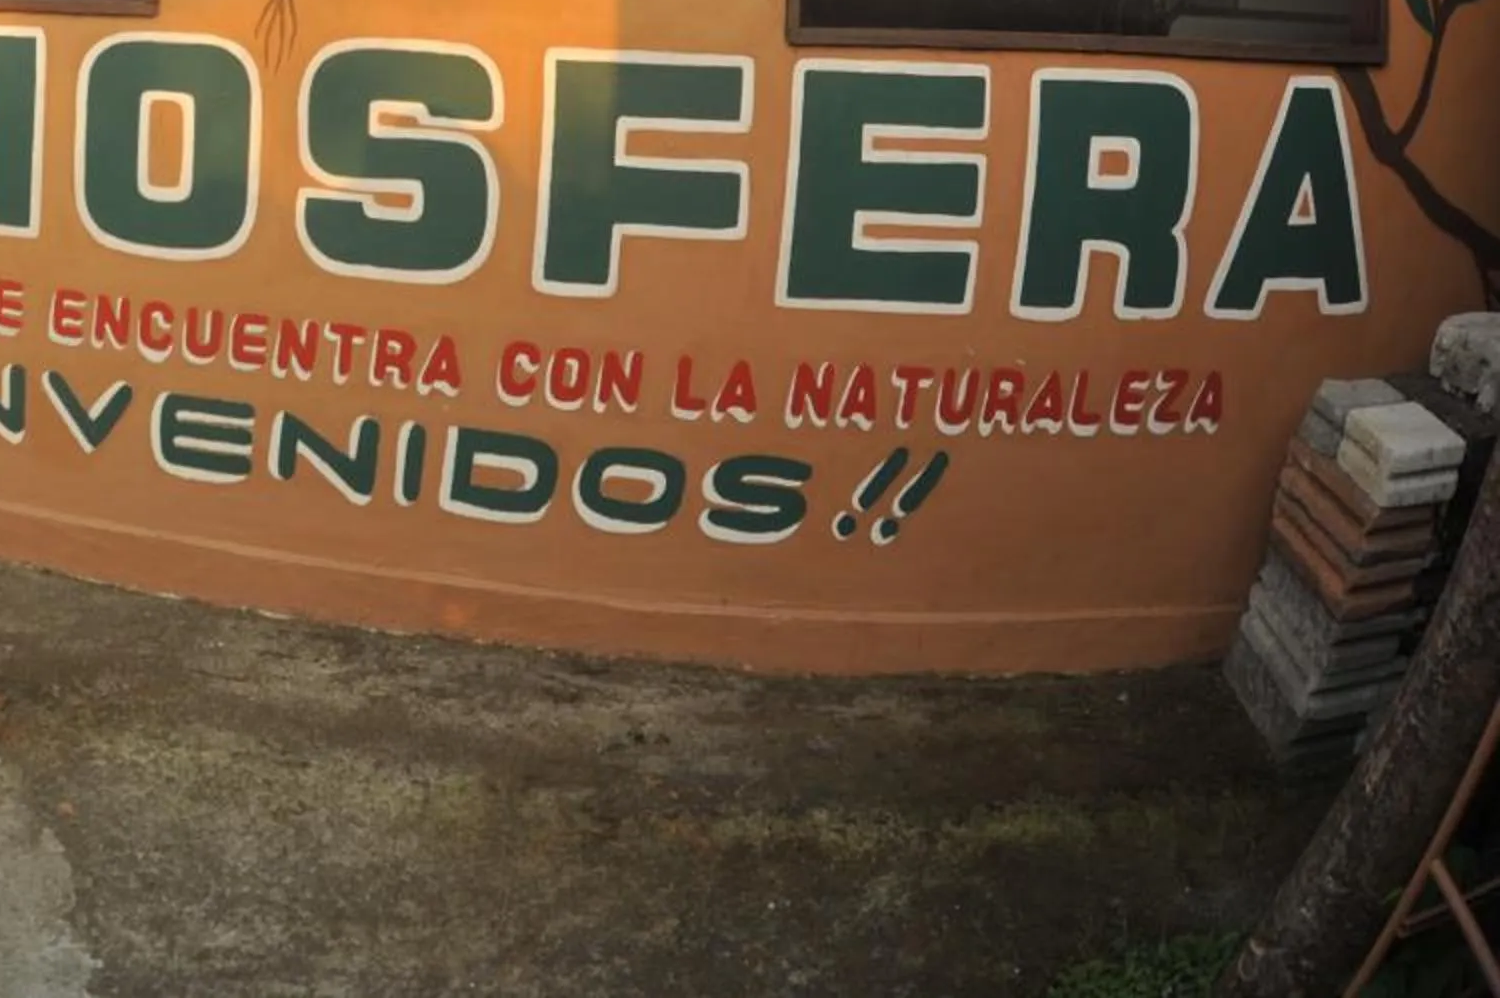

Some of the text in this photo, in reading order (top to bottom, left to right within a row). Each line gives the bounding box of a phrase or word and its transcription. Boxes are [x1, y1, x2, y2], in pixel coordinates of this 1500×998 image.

[47, 286, 463, 396] ENCUENTRA
[496, 340, 645, 413] CON
[669, 355, 758, 423] LA
[783, 360, 1225, 437] NATURALEZA
